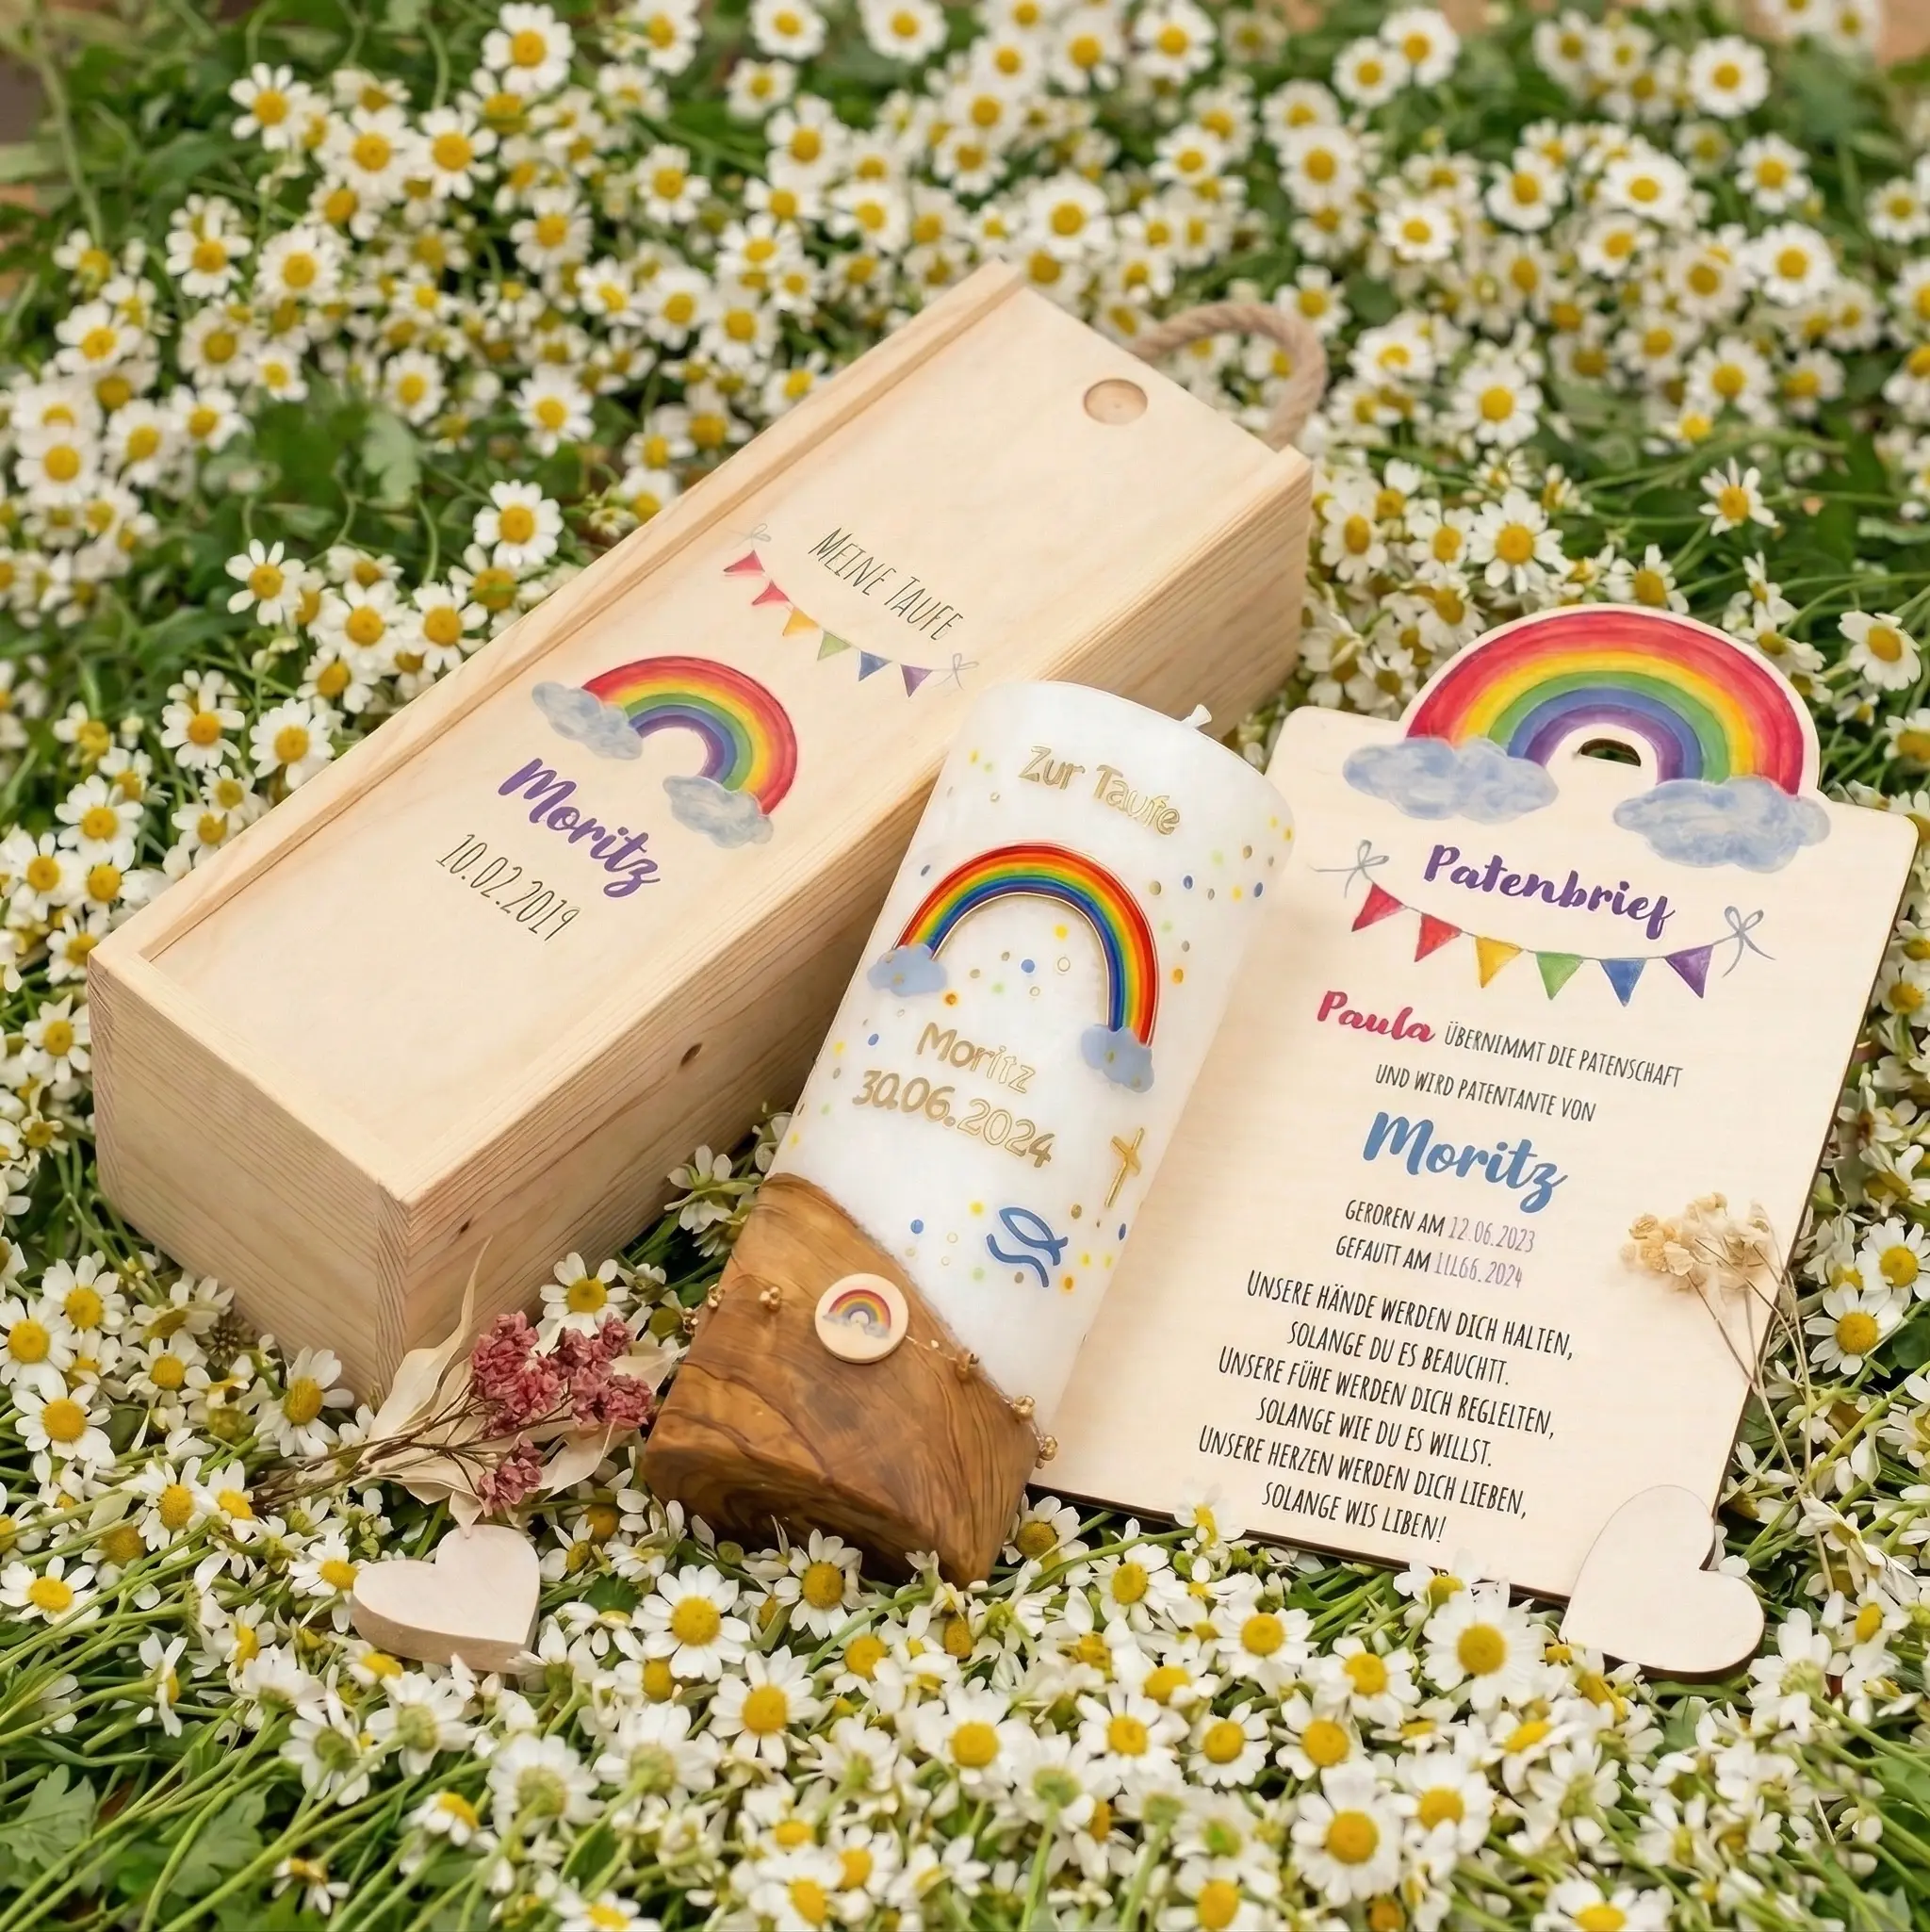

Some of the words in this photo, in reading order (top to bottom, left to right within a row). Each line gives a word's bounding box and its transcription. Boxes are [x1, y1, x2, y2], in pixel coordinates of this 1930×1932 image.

[808, 528, 896, 596] MEINE
[884, 577, 963, 640] TAUFE
[1019, 746, 1085, 790] Zur
[498, 757, 661, 900] Moritz
[436, 834, 580, 941] 10.02.2019
[1423, 844, 1676, 940] Patenbrief
[917, 1023, 1036, 1093] Moritz
[1316, 991, 1435, 1044] Paula
[1445, 1022, 1546, 1062] ÜBERNIMMT
[1547, 1045, 1577, 1068] DIE
[1578, 1050, 1683, 1088] PATENSCHAFT
[1376, 1064, 1410, 1088] UND
[1415, 1071, 1454, 1096] WIRD
[1458, 1079, 1557, 1115] PATENTANTE
[1562, 1097, 1596, 1122] VON
[1363, 1112, 1568, 1213] Moritz
[1402, 1248, 1431, 1272] AM
[1416, 1213, 1446, 1236] AM
[1448, 1217, 1534, 1253] 12.06.2023
[1287, 1321, 1366, 1357] SOLANGE
[1369, 1336, 1395, 1363] DU
[1398, 1342, 1418, 1367] ES
[1317, 1284, 1378, 1318] HÄNDE
[1381, 1298, 1451, 1333] WERDEN
[1456, 1312, 1498, 1341] DICH
[1502, 1321, 1572, 1360] HALTEN,
[1287, 1360, 1333, 1392] FÜHE
[1335, 1371, 1407, 1406] WERDEN
[1411, 1386, 1452, 1416] DICH
[1256, 1397, 1335, 1434] SOLANGE
[1339, 1414, 1373, 1442] WIE
[1375, 1420, 1402, 1447] DU
[1404, 1426, 1425, 1451] ES
[1430, 1432, 1491, 1466] WILLST.
[1262, 1482, 1341, 1520] SOLANGE
[1346, 1499, 1378, 1528] WIS
[1382, 1507, 1447, 1543] LIBEN!
[1268, 1441, 1334, 1476] HERZEN
[1338, 1455, 1410, 1491] WERDEN
[1414, 1471, 1457, 1501] DICH
[1460, 1480, 1526, 1519] LIEBEN,
